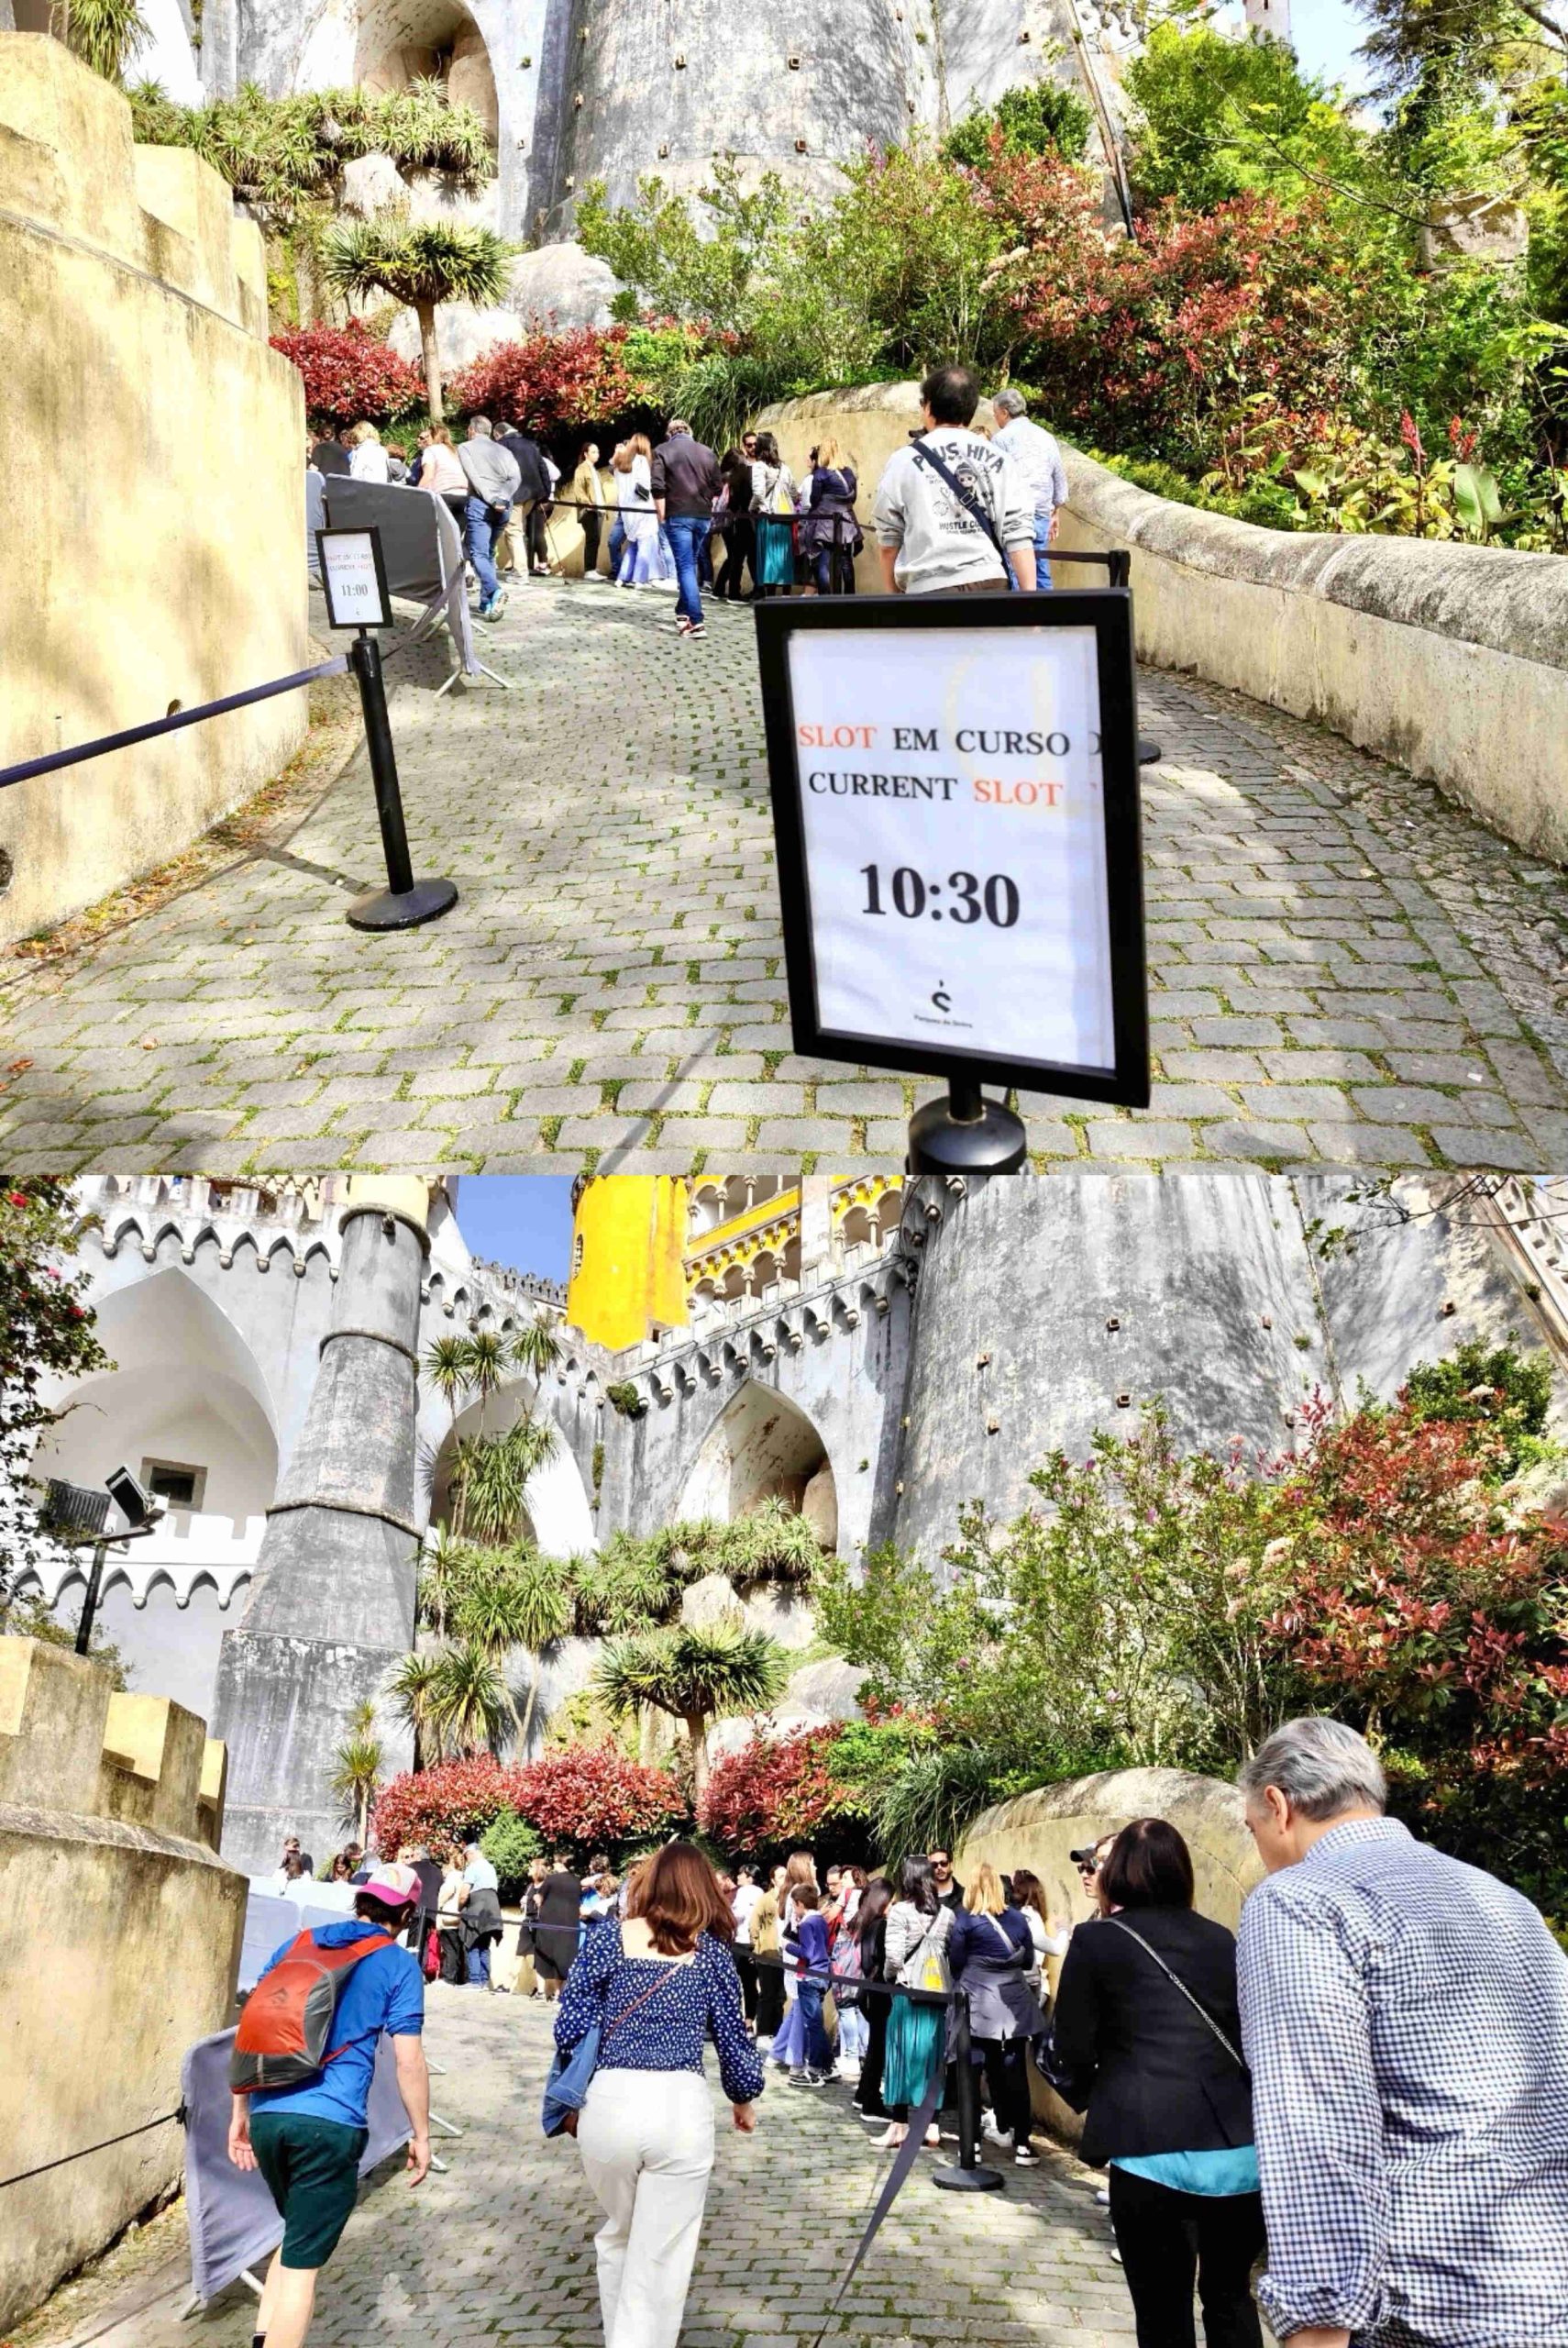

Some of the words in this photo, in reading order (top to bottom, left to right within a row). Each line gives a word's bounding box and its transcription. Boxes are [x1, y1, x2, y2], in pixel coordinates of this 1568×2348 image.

[341, 583, 369, 596] 11:00
[798, 725, 878, 750] SLOT
[893, 727, 939, 752] EM
[955, 729, 1071, 757] CURSO
[809, 771, 958, 801] CURRENT
[974, 780, 1063, 807] SLOT
[860, 863, 1020, 928] 10:30
